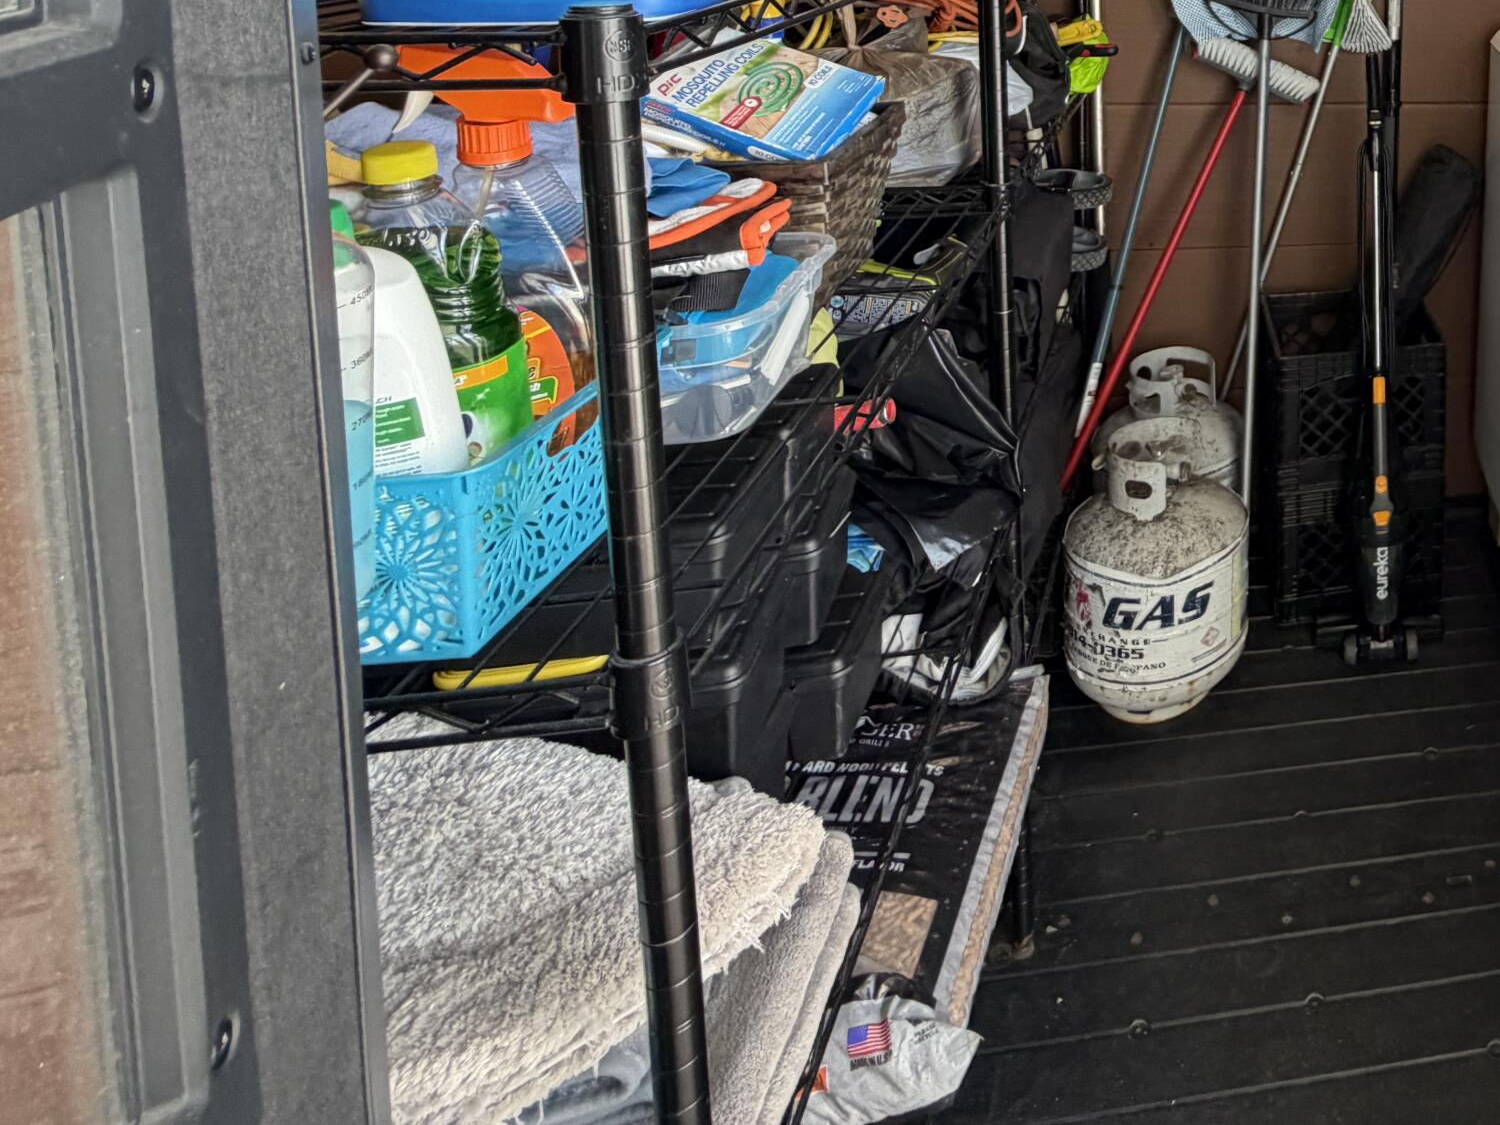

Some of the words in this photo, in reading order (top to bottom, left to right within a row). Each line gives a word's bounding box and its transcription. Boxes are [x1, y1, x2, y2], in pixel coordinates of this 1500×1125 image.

[672, 59, 726, 102] MOSQUITO
[687, 63, 740, 107] REPELLING
[735, 43, 765, 68] COILS
[1373, 546, 1389, 600] eureka
[1102, 580, 1215, 631] GAS
